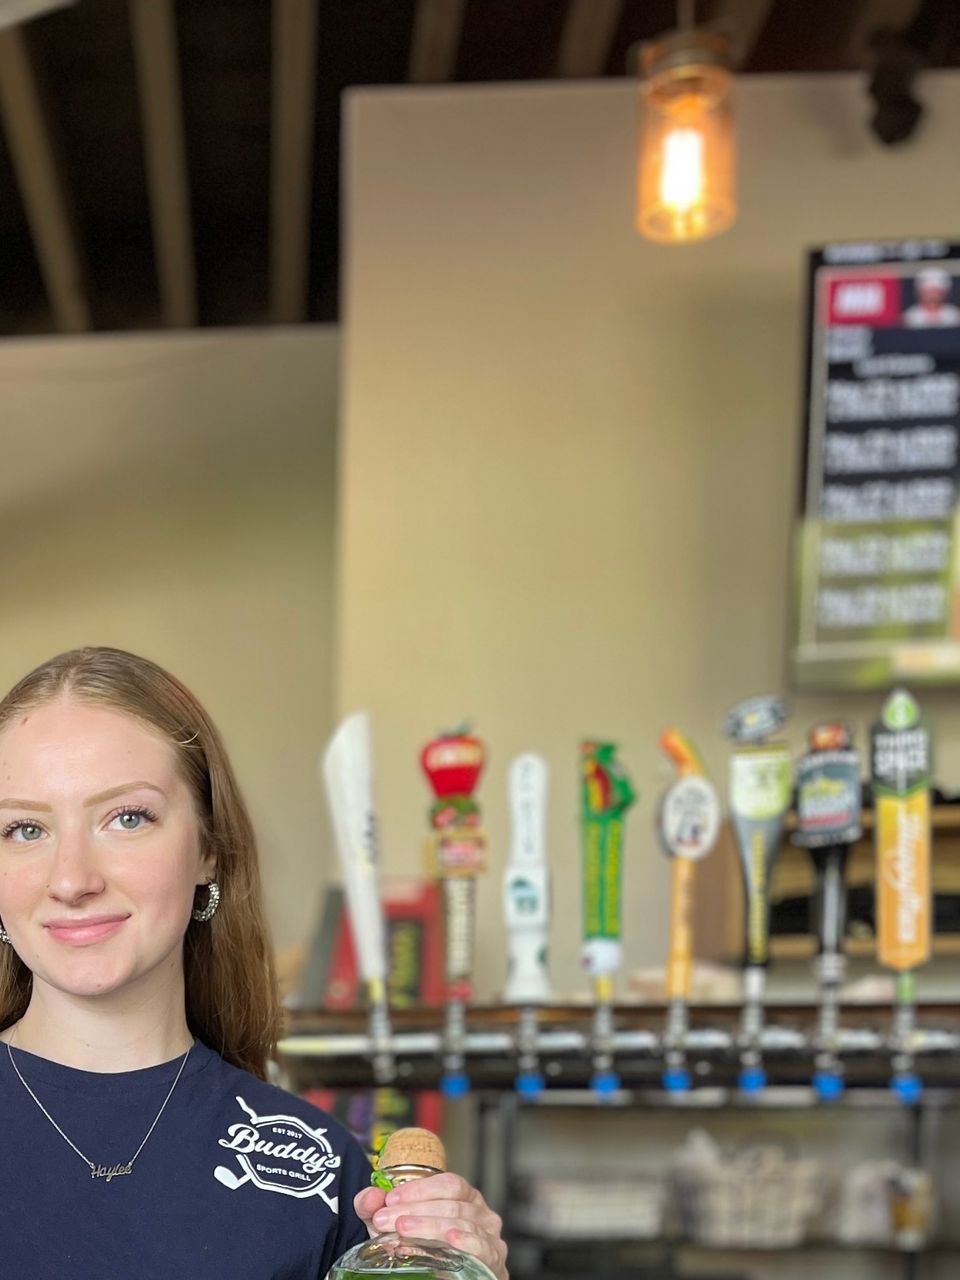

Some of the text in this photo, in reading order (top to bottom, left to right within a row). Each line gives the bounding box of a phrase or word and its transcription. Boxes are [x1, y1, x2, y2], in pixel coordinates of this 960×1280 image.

[286, 1129, 302, 1139] 2017
[218, 1123, 341, 1174] Buddy's
[256, 1164, 311, 1181] SPORTS GRILL
